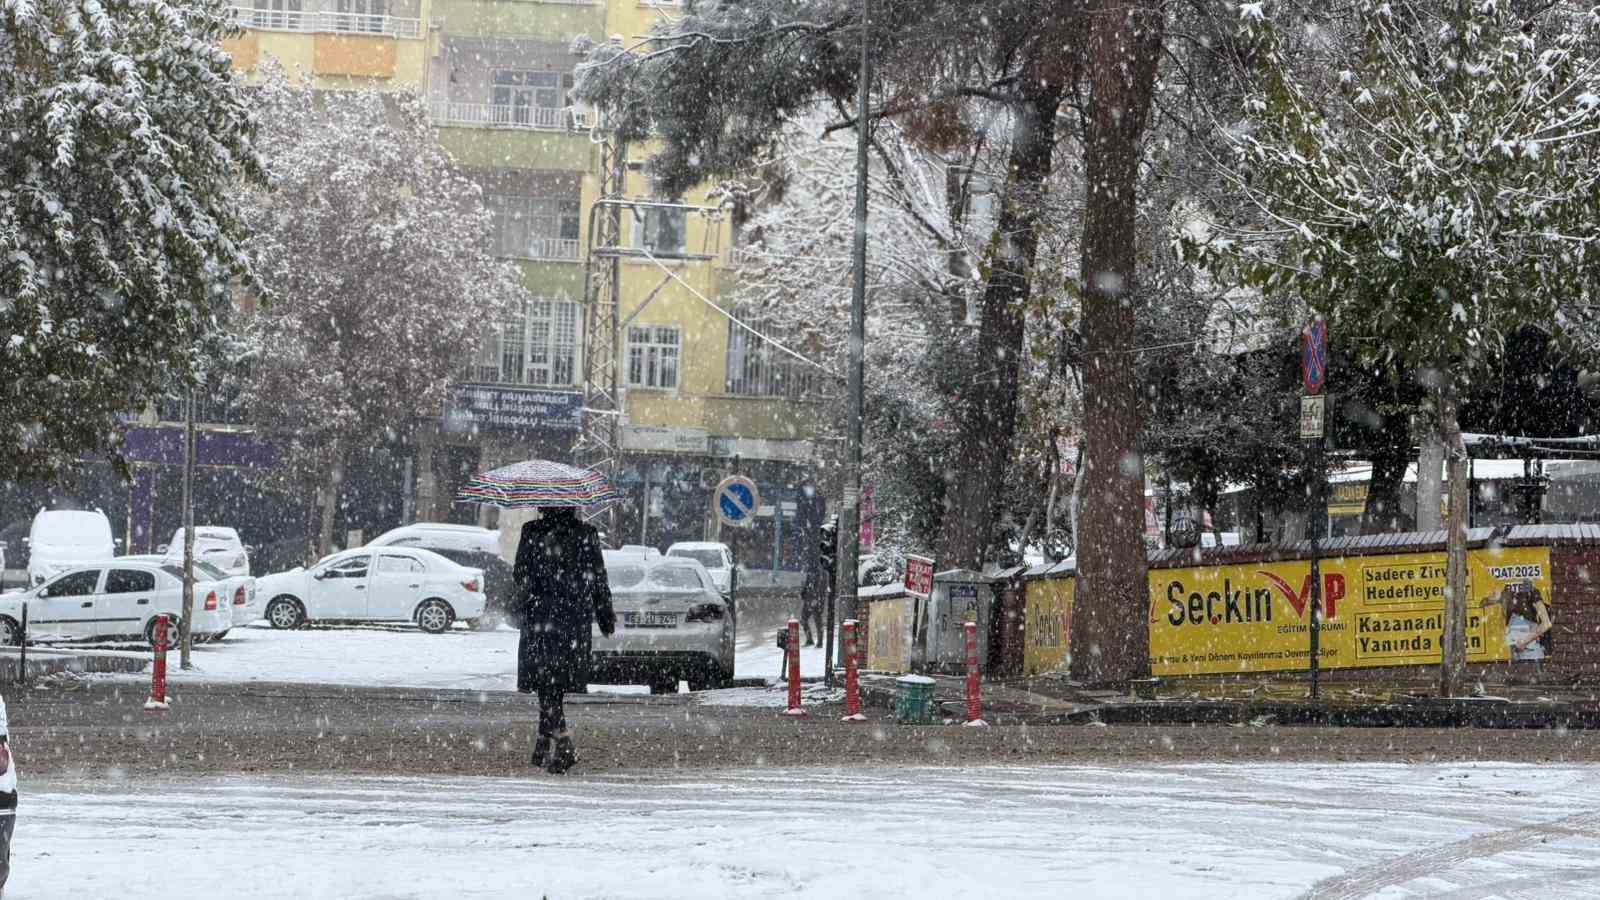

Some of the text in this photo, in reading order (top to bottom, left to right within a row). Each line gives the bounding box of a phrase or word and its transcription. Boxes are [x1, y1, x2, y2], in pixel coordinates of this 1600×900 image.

[1515, 565, 1540, 578] 2025
[1256, 570, 1346, 619] VP
[1366, 584, 1470, 600] Hedefleyer
[1358, 614, 1479, 633] Kazananlın
[1360, 636, 1432, 653] Yanında
[1318, 647, 1338, 659] diyor
